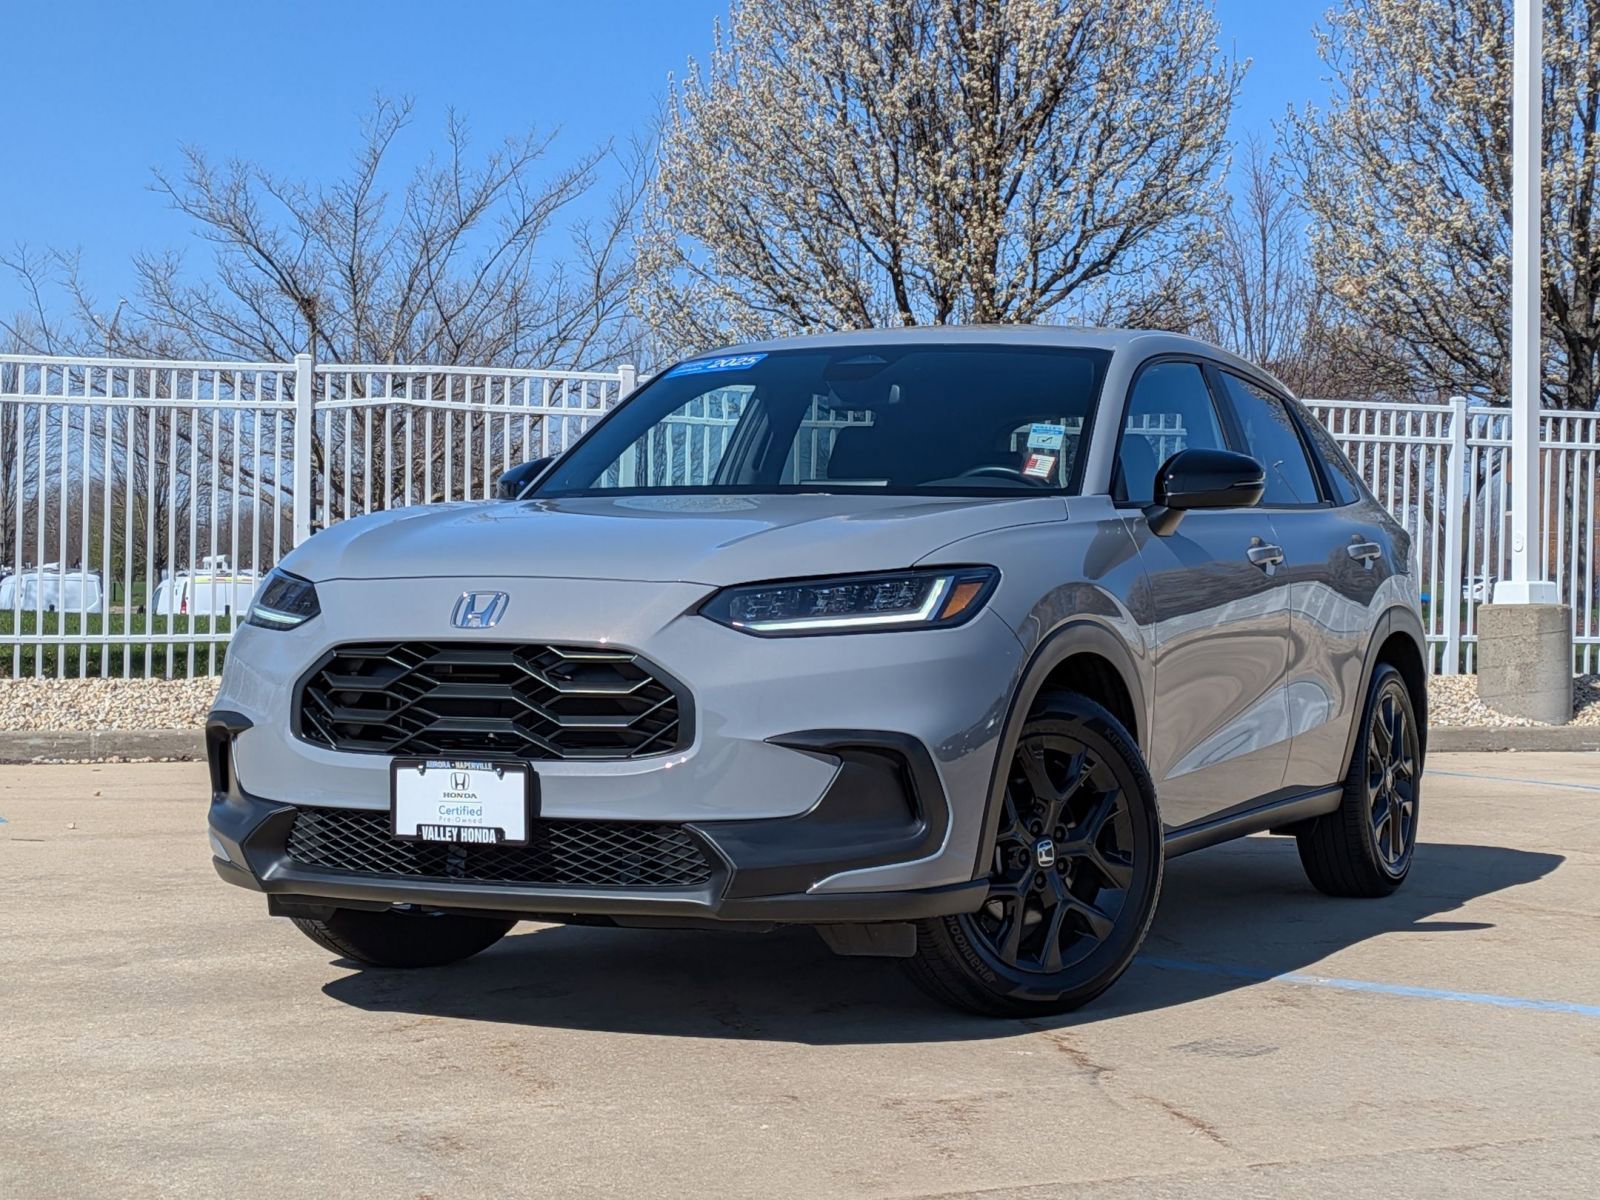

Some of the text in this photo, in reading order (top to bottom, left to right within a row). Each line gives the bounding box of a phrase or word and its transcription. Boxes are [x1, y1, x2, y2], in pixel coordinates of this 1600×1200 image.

[706, 356, 758, 369] 2025
[455, 761, 493, 770] NAPERVILLE
[438, 805, 483, 816] Certified
[421, 826, 497, 844] VALLEY HONDA
